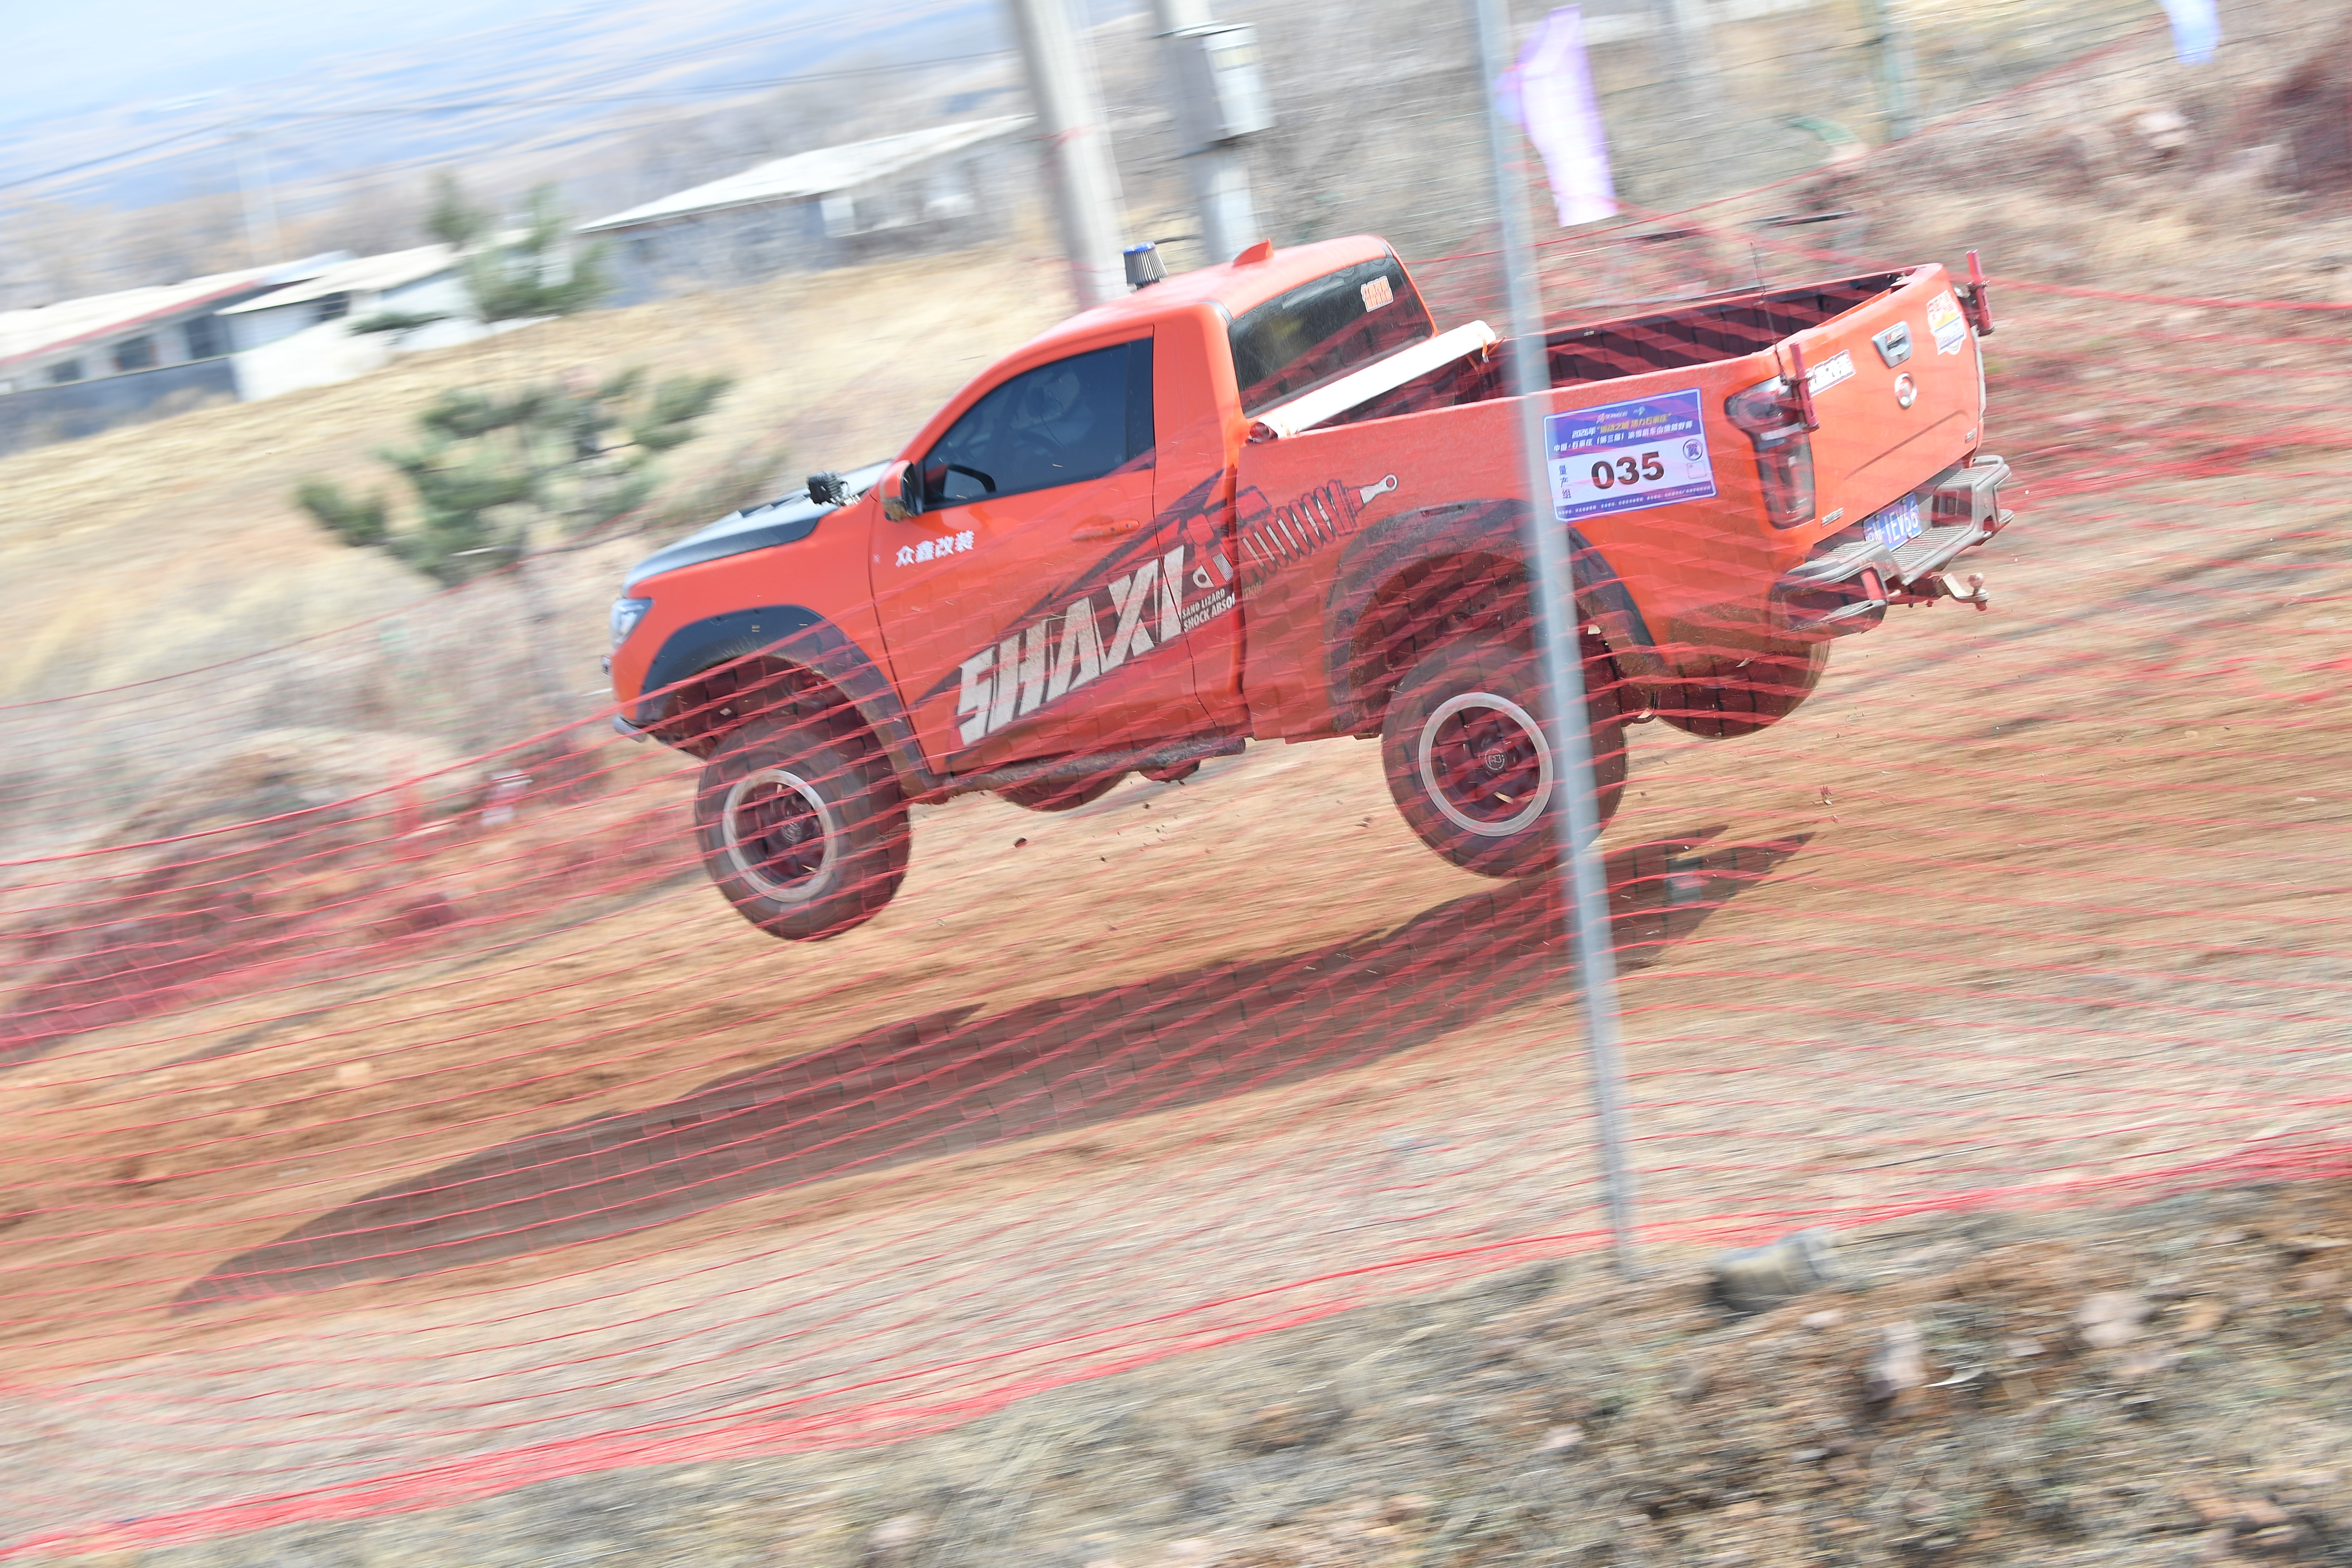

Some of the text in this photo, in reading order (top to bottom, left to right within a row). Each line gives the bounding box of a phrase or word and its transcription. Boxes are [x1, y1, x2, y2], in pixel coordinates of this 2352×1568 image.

[1558, 464, 1572, 499] 量产组
[1591, 451, 1664, 489] 035
[896, 530, 975, 567] 众鑫改装
[1182, 588, 1225, 619] SAND LIZARD
[1183, 608, 1211, 633] SHOCK
[957, 544, 1184, 746] SHAXI
